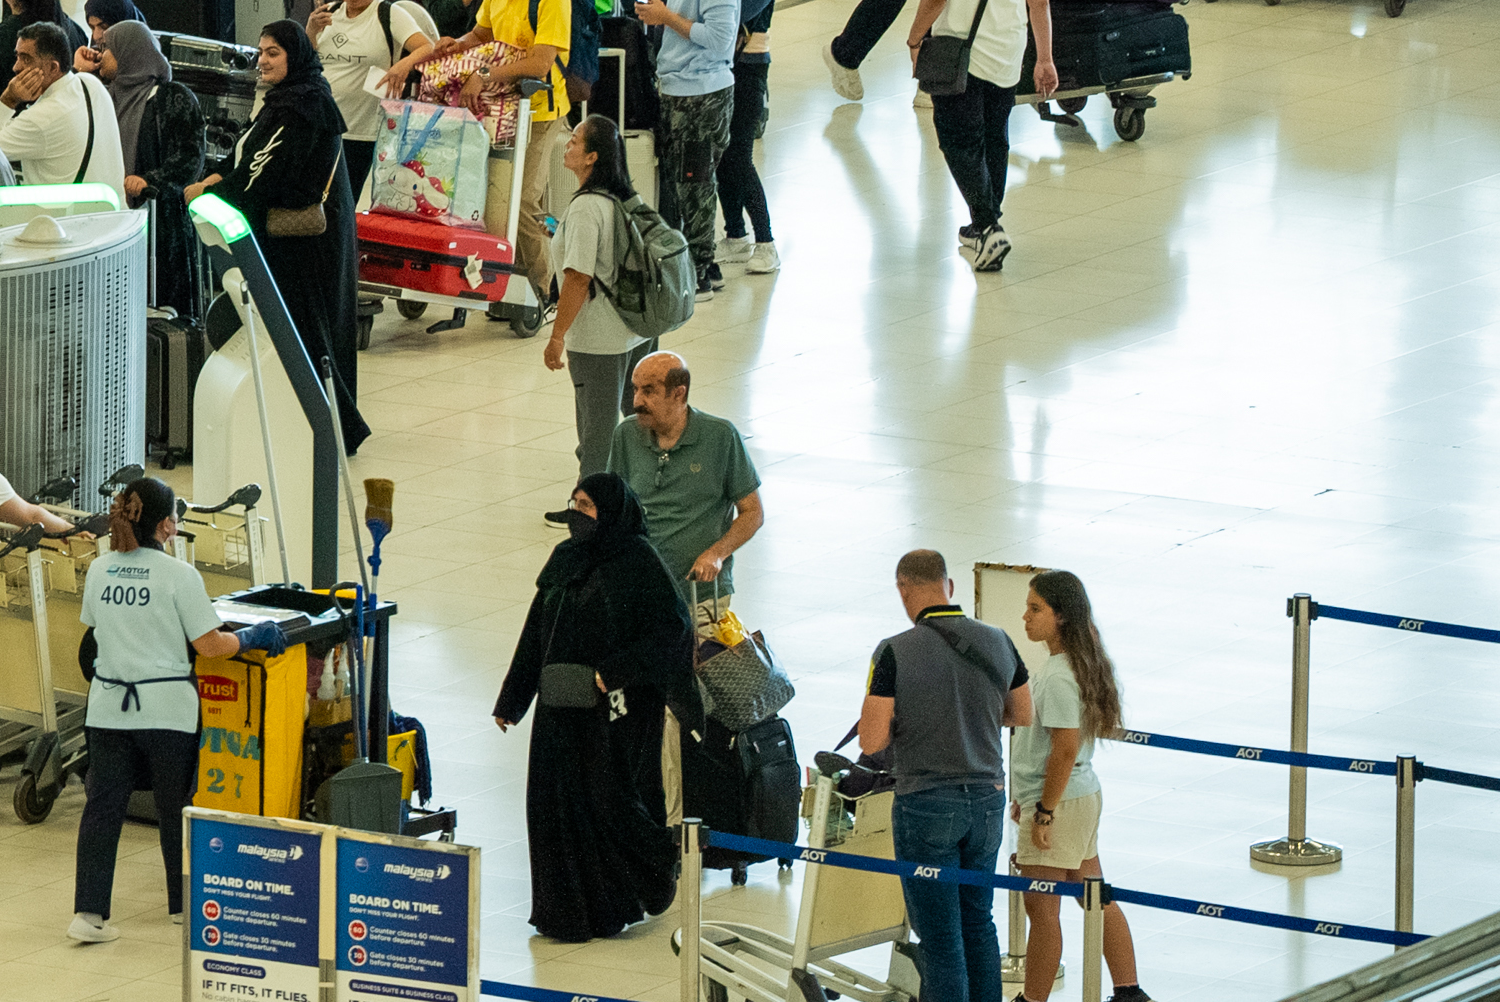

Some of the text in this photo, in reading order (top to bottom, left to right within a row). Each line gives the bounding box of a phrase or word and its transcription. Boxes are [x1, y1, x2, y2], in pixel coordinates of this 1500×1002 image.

[100, 585, 150, 607] 4009
[1398, 619, 1424, 631] AOT
[1124, 731, 1150, 744] AOT
[1349, 760, 1376, 773] AOT
[237, 843, 288, 860] malaysia
[384, 863, 435, 879] malaysia
[913, 866, 941, 879] AOT
[203, 873, 295, 896] BOARD ON TIME.
[221, 889, 234, 897] MISS
[235, 891, 251, 899] YOUR
[349, 893, 443, 915] BOARD ON TIME.
[1197, 904, 1225, 918] AOT
[223, 906, 249, 915] Counter
[250, 910, 270, 919] closes
[281, 915, 307, 924] minutes
[223, 914, 278, 927] before departure.
[369, 926, 455, 943] Counter closes 60 minutes
[1315, 923, 1343, 936] AOT
[222, 939, 278, 953] before departure.
[223, 931, 238, 940] Gate
[239, 934, 259, 943] closes
[270, 939, 296, 948] minutes
[369, 933, 425, 947] before departure.
[369, 951, 385, 960] Gate
[386, 954, 407, 963] closes
[418, 958, 444, 967] minutes
[369, 958, 426, 972] before departure.
[206, 962, 263, 977] ECONOMY CLASS
[202, 979, 213, 989] IF
[216, 981, 227, 991] IT
[230, 983, 258, 998] FITS,
[261, 987, 272, 998] IT
[352, 982, 381, 992] BUSINESS
[381, 986, 399, 994] SUITE
[405, 990, 434, 999] BUSINESS
[434, 993, 455, 1002] CLASS
